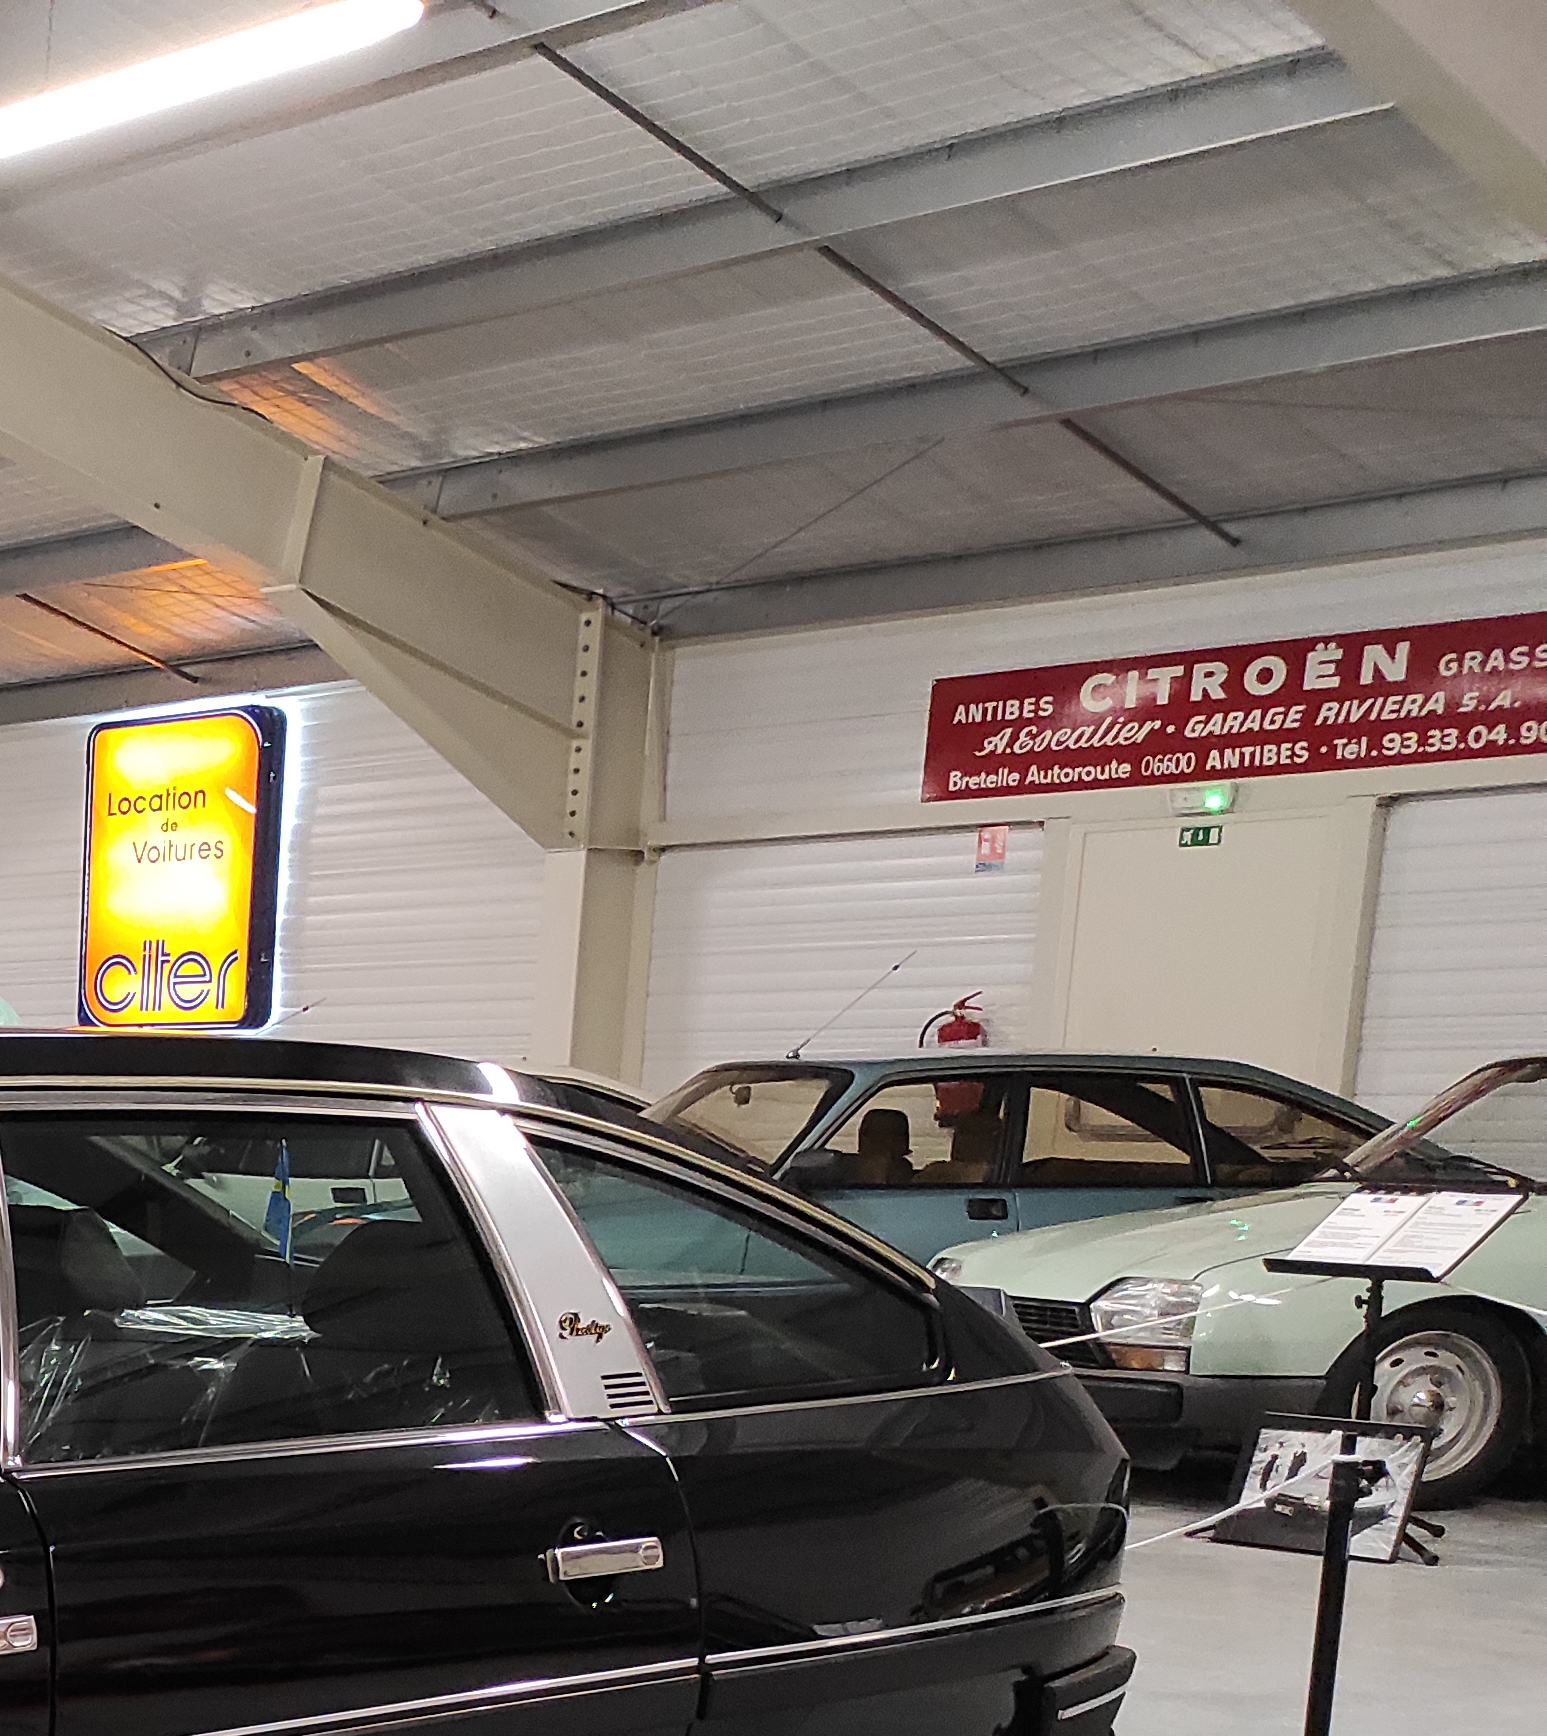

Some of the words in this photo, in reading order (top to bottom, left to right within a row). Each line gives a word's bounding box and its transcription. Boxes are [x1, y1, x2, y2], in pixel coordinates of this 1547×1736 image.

[953, 696, 1055, 725] ANTIBES
[1079, 641, 1411, 713] CITROËN
[1184, 705, 1307, 738] GARAGE
[1314, 691, 1446, 726] RIVIERA
[1457, 688, 1522, 713] S.A.
[948, 768, 1019, 792] Bretelle
[1024, 759, 1132, 785] Autoroute
[1141, 752, 1196, 777] 06600
[1205, 741, 1309, 770] ANTIBES
[107, 786, 207, 817] Location
[160, 818, 178, 833] de
[132, 840, 224, 864] Voitures
[93, 939, 239, 1013] citer
